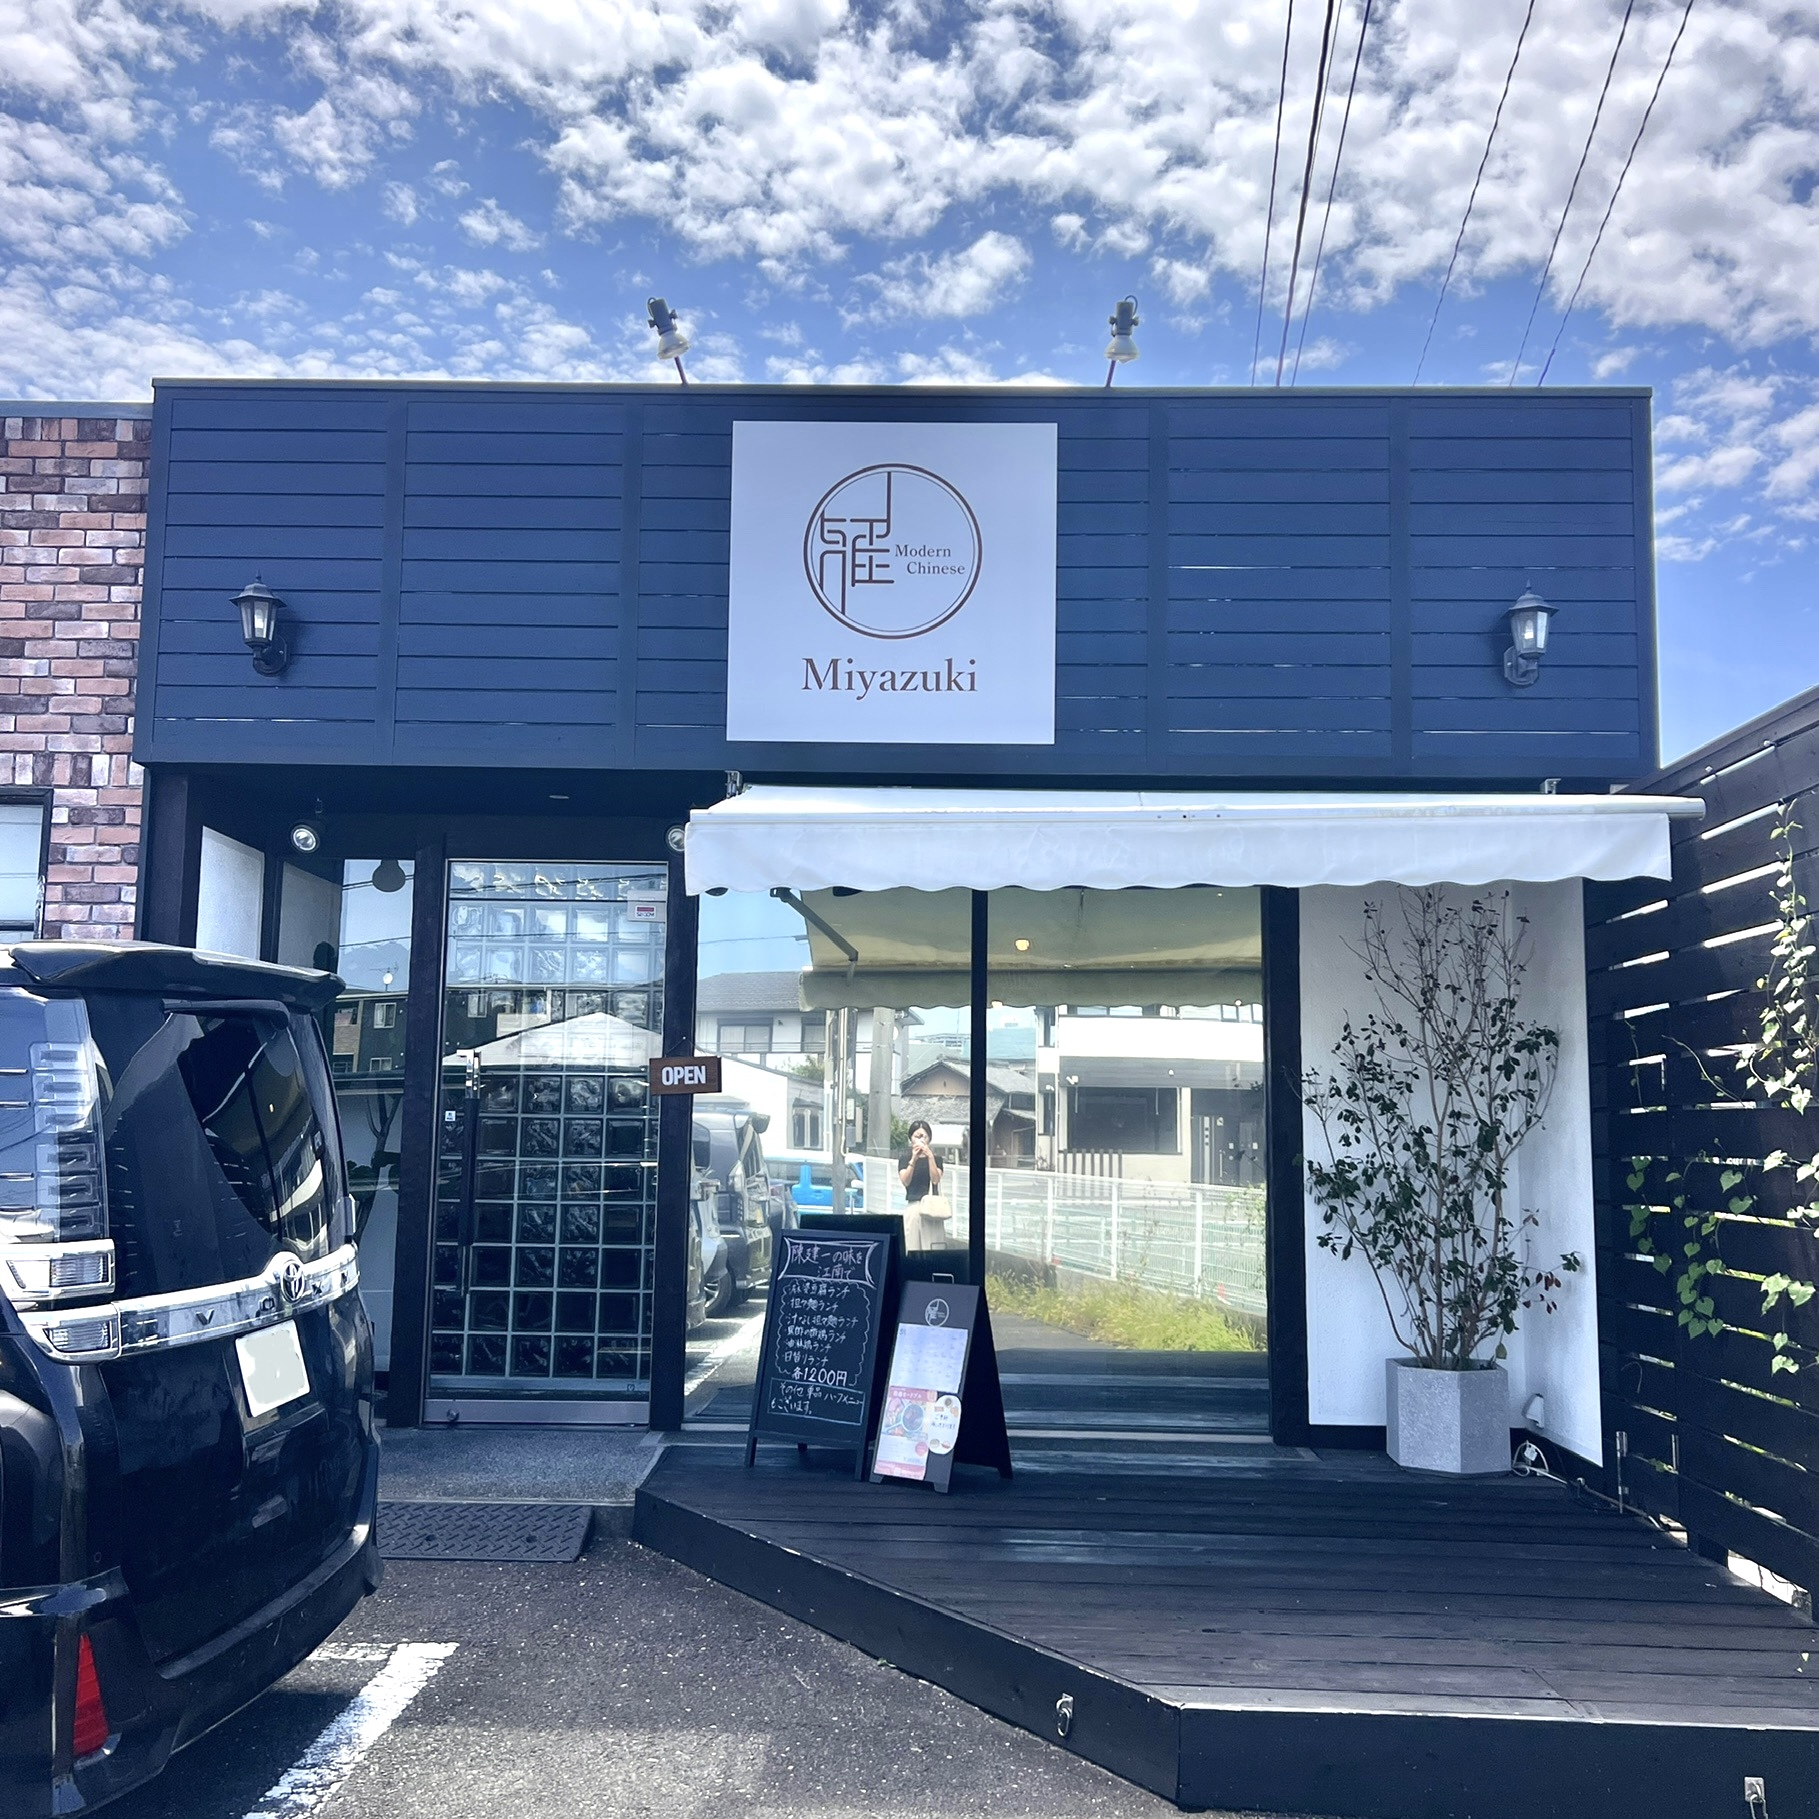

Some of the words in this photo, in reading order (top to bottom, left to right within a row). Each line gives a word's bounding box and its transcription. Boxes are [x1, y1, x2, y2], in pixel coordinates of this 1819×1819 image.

[894, 544, 952, 558] Modern
[906, 561, 966, 575] Chinese
[801, 657, 978, 701] Miyazuki
[661, 1065, 706, 1087] OPEN
[790, 1243, 863, 1265] 陳建一の味を
[817, 1264, 856, 1281] 江南で
[791, 1366, 848, 1387] 各1200円
